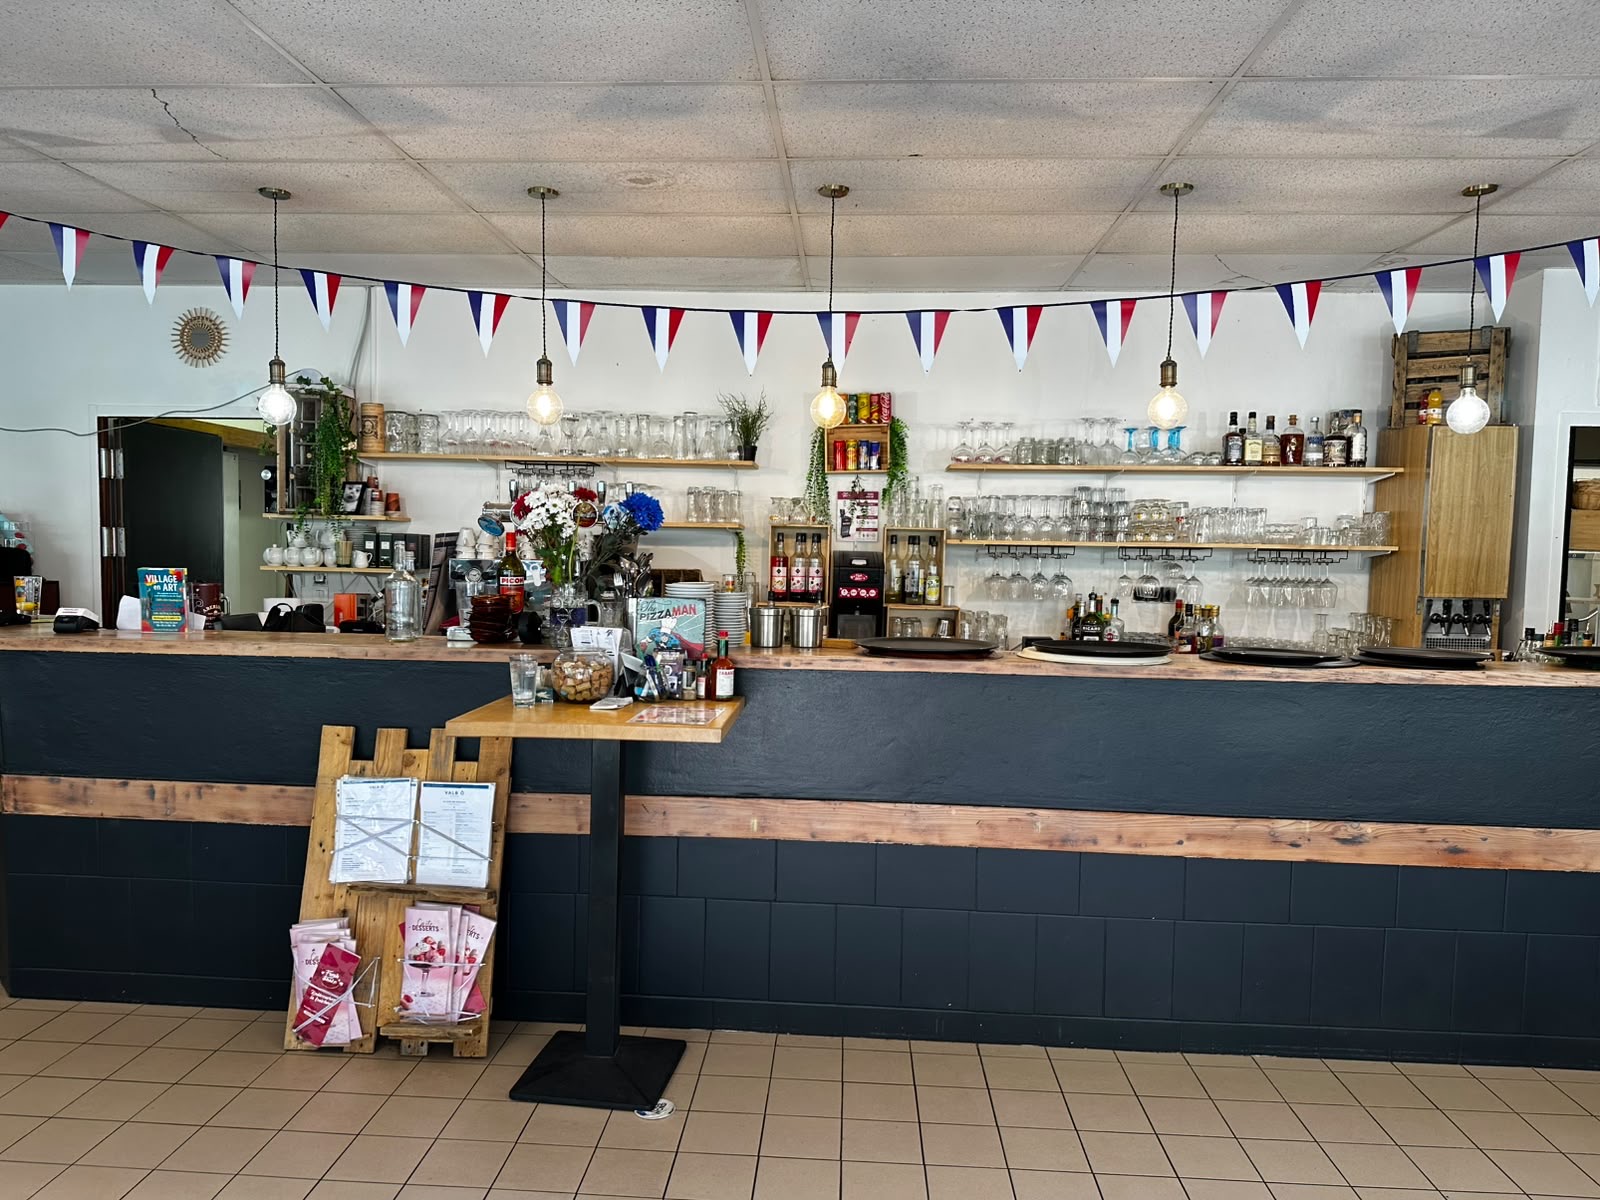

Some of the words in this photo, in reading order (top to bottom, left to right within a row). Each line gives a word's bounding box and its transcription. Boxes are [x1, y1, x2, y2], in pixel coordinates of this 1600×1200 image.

[145, 574, 178, 583] VILLAGE
[162, 583, 178, 592] ART
[412, 924, 439, 932] DESSERTS
